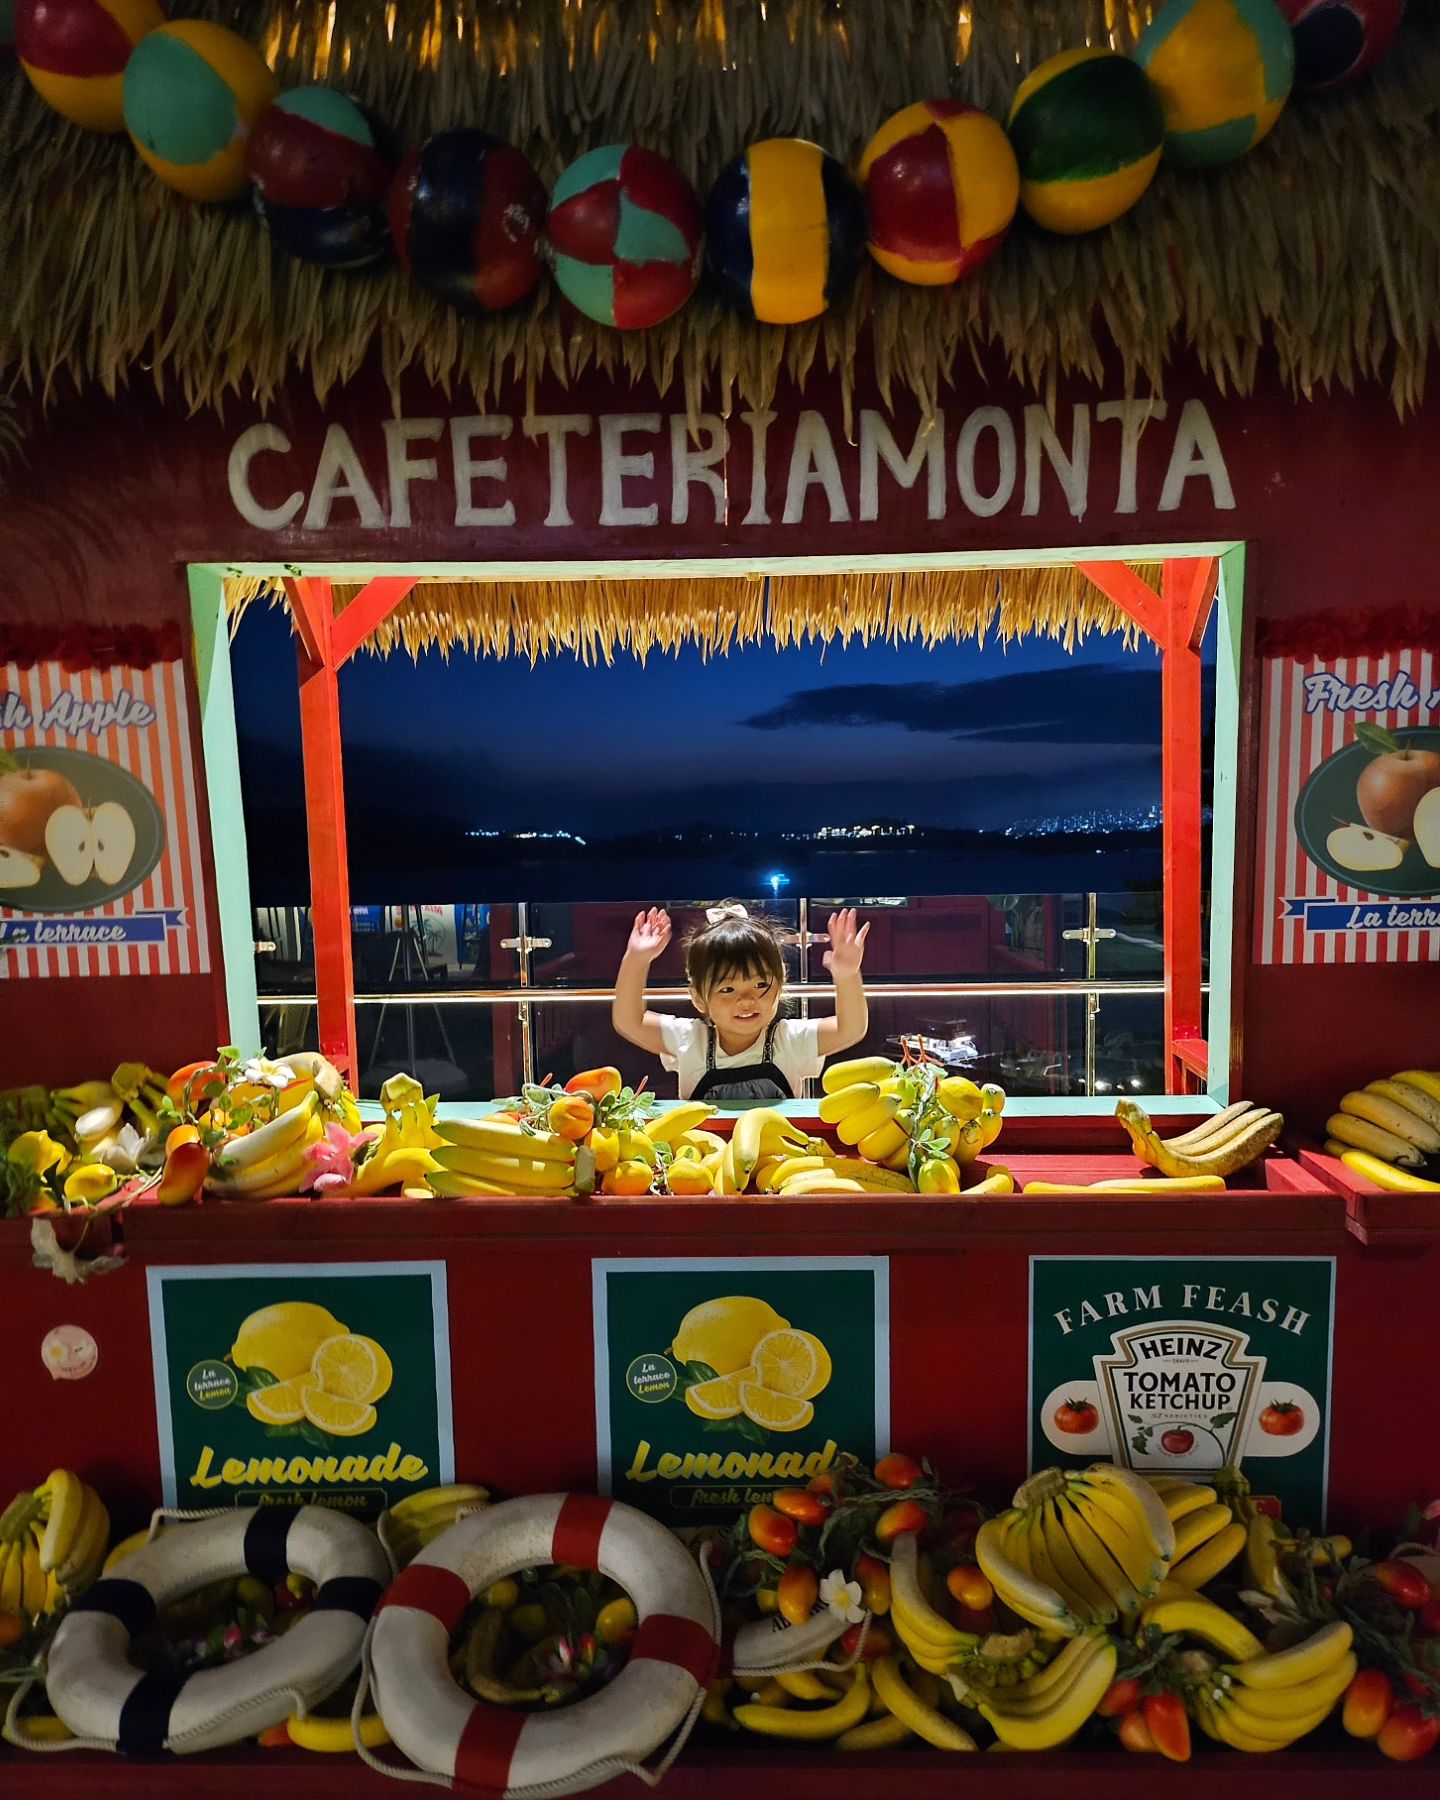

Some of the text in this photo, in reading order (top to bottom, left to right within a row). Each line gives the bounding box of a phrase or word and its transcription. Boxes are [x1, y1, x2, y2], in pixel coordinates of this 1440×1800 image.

[1303, 671, 1420, 713] Fresh
[41, 689, 156, 736] Apple
[1346, 905, 1440, 929] La terr
[34, 921, 127, 944] terrace
[1053, 1284, 1311, 1335] FARM FEASH
[1138, 1338, 1222, 1360] HEINZ
[202, 1368, 217, 1380] La
[633, 1371, 671, 1385] terrace
[641, 1363, 656, 1373] La
[194, 1377, 231, 1391] terrace
[638, 1382, 670, 1394] Lemon
[1123, 1372, 1236, 1392] TOMATO
[199, 1387, 231, 1401] Lemon
[1130, 1393, 1230, 1410] KETCHUP
[190, 1442, 429, 1489] Lemonade
[689, 1487, 741, 1507] fresh
